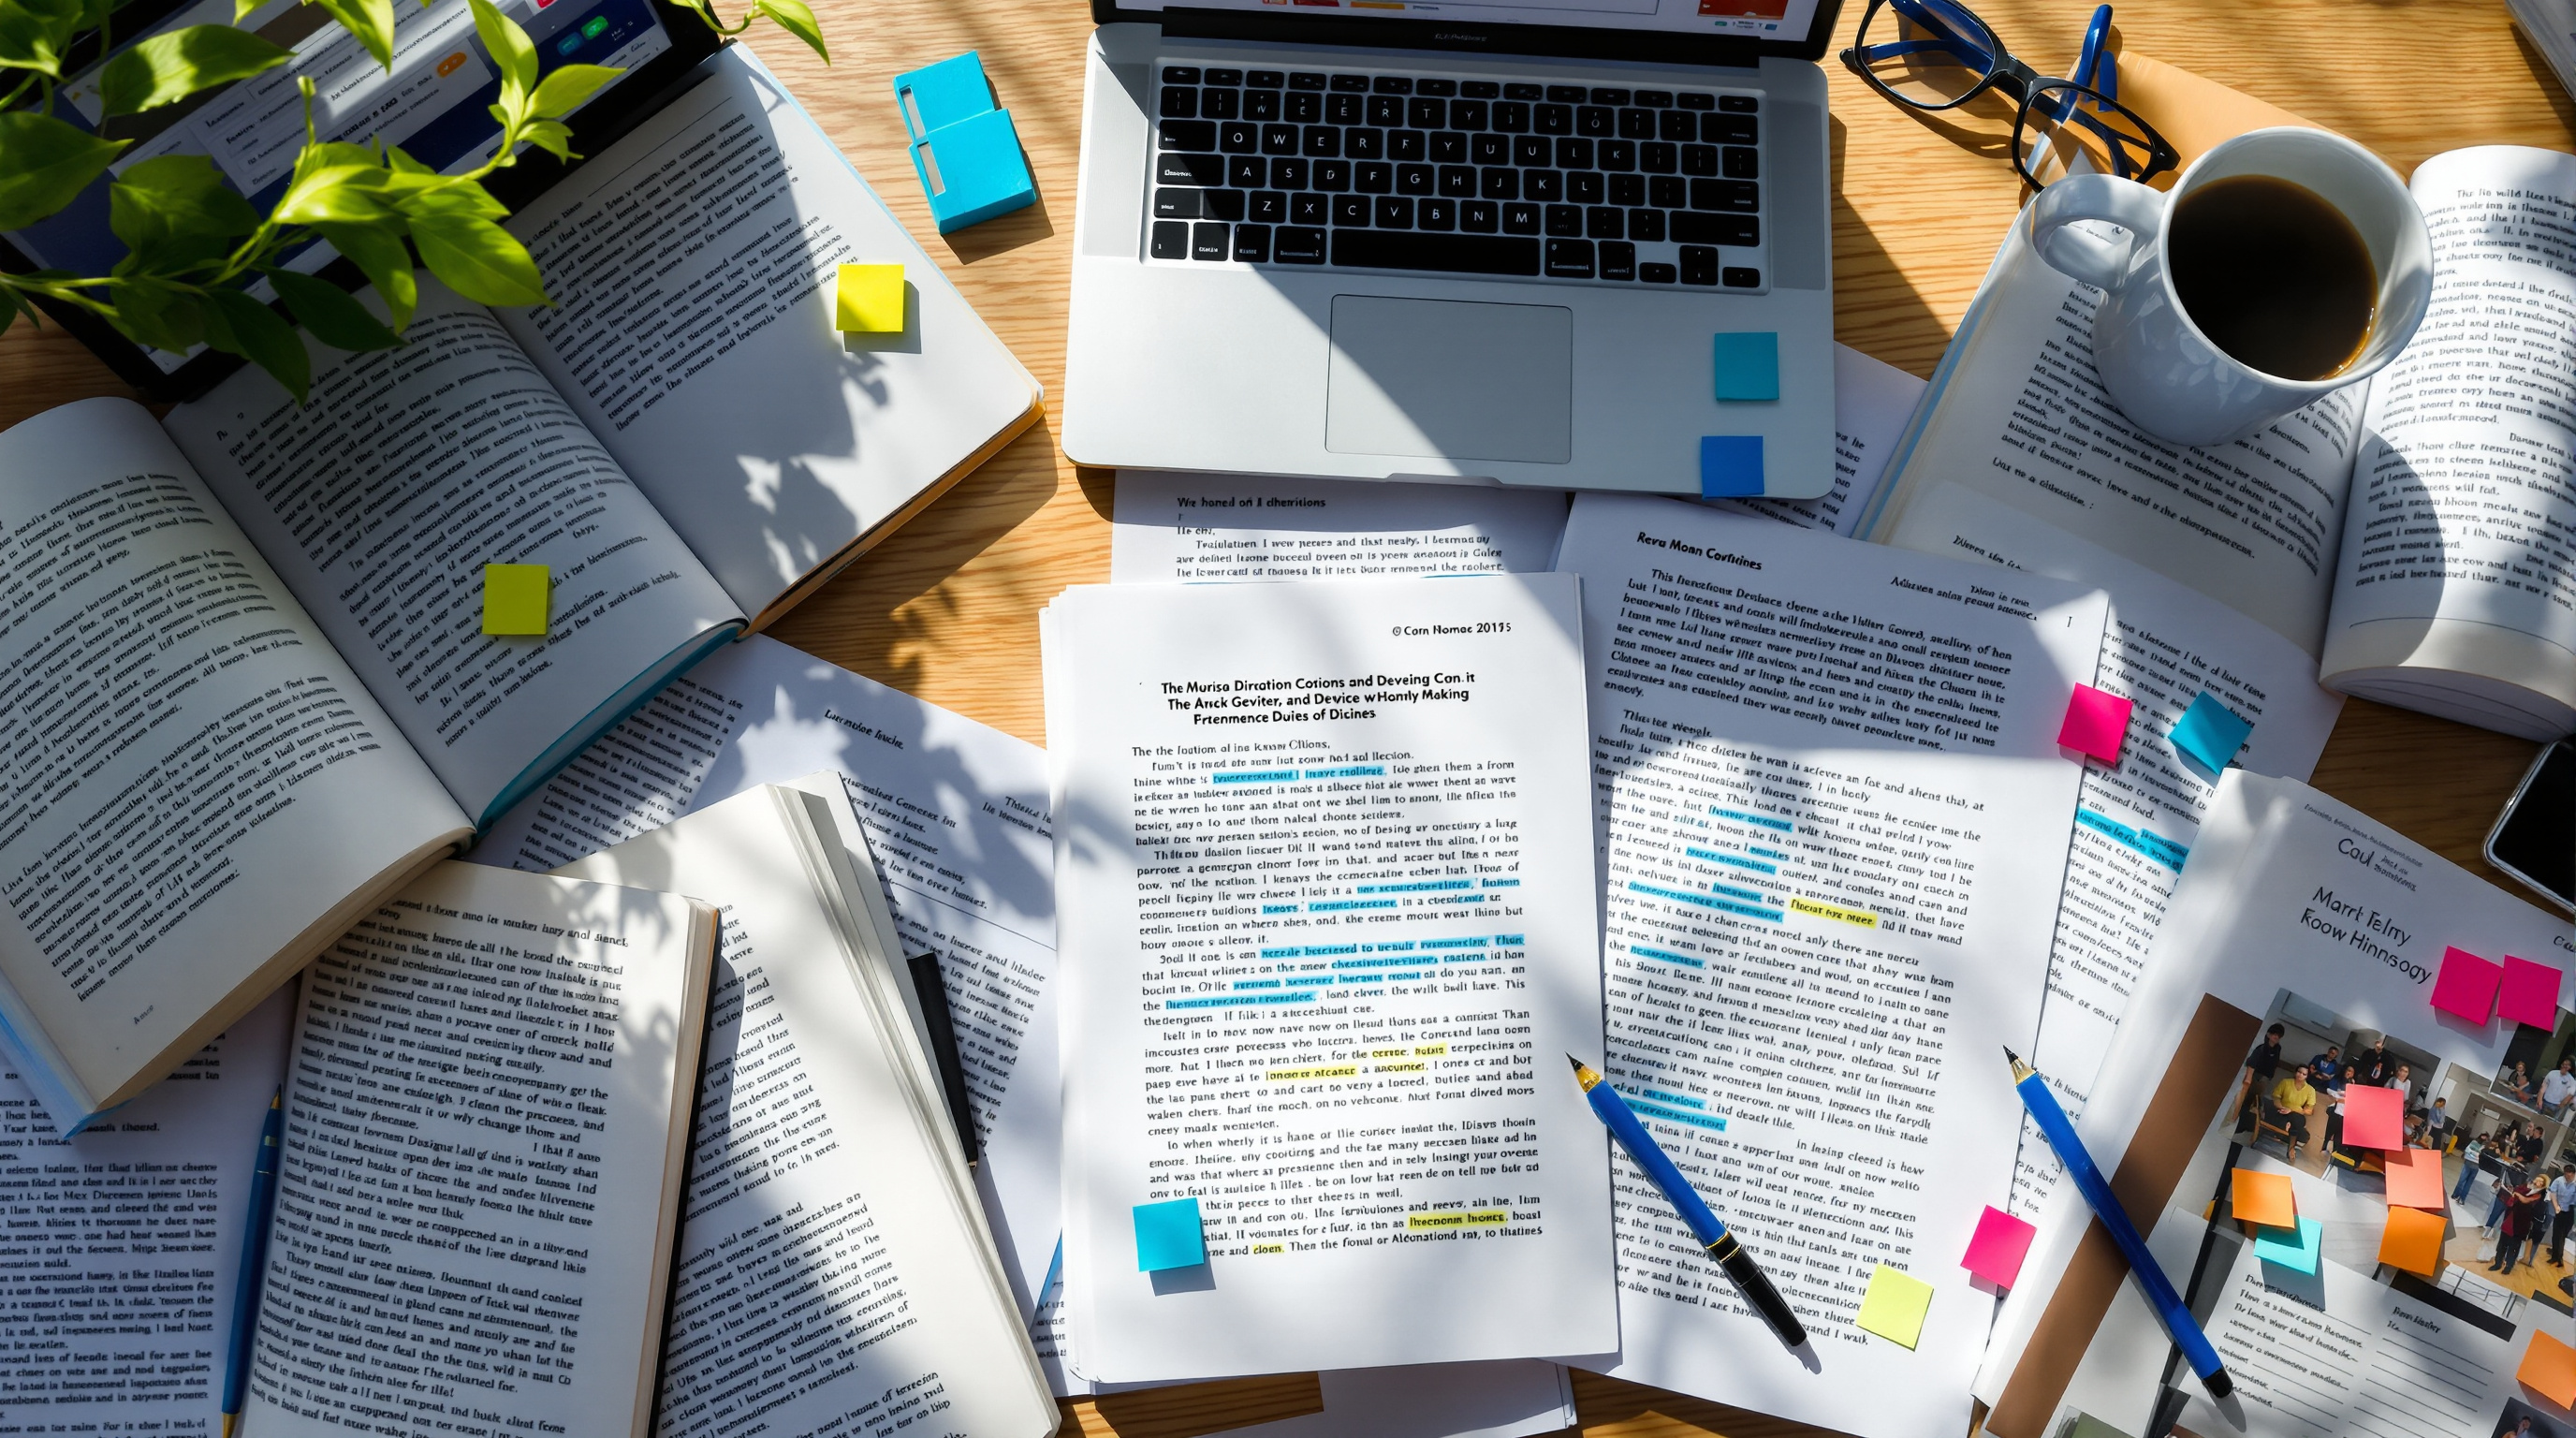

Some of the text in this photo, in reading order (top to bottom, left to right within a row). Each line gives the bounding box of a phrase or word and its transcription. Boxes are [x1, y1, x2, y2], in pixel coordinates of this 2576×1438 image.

[1383, 109, 1388, 117] R
[1424, 109, 1430, 118] T
[1234, 133, 1242, 142] O
[1274, 135, 1285, 144] W
[1318, 137, 1324, 146] E
[1360, 139, 1366, 148] R
[1486, 145, 1494, 154] U
[1529, 147, 1535, 155] U
[1243, 168, 1251, 176] A
[1286, 169, 1292, 177] S
[1327, 170, 1334, 179] D
[1411, 174, 1420, 183] G
[1453, 176, 1460, 184] H
[1497, 178, 1501, 187] J
[1539, 180, 1545, 188] K
[1583, 182, 1588, 190] L
[1264, 201, 1271, 211] Z
[1306, 204, 1313, 213] X
[1348, 206, 1355, 215] C
[1391, 207, 1398, 216] V
[1474, 212, 1483, 220] N
[1516, 213, 1527, 222] M
[1652, 569, 1673, 581] This
[1162, 682, 1183, 694] The
[1187, 682, 1229, 693] Murisa
[1350, 675, 1372, 687] and
[1377, 674, 1429, 686] Deveing
[1168, 698, 1191, 710] The
[1287, 694, 1310, 705] and
[1314, 693, 1359, 704] Device
[1423, 689, 1469, 701] Making
[1313, 709, 1325, 720] of
[1330, 709, 1376, 719] Dicines
[1133, 746, 1173, 756] The the
[1964, 830, 1981, 841] the
[1767, 896, 1784, 906] the
[1506, 907, 1522, 916] but
[1143, 972, 1164, 980] that
[1801, 967, 1821, 976] and
[1144, 1002, 1160, 1010] the
[1490, 1056, 1508, 1065] and
[1148, 1085, 1294, 1104] the and
[1184, 1139, 1211, 1148] when
[1346, 1144, 1362, 1152] the
[1388, 1142, 1418, 1151] many
[1150, 1173, 1168, 1182] and
[1340, 1160, 1363, 1168] then
[1368, 1157, 1387, 1167] and
[1409, 1201, 1427, 1211] and
[1243, 1214, 1261, 1223] and
[1303, 1225, 1318, 1235] for
[1229, 1246, 1248, 1255] and
